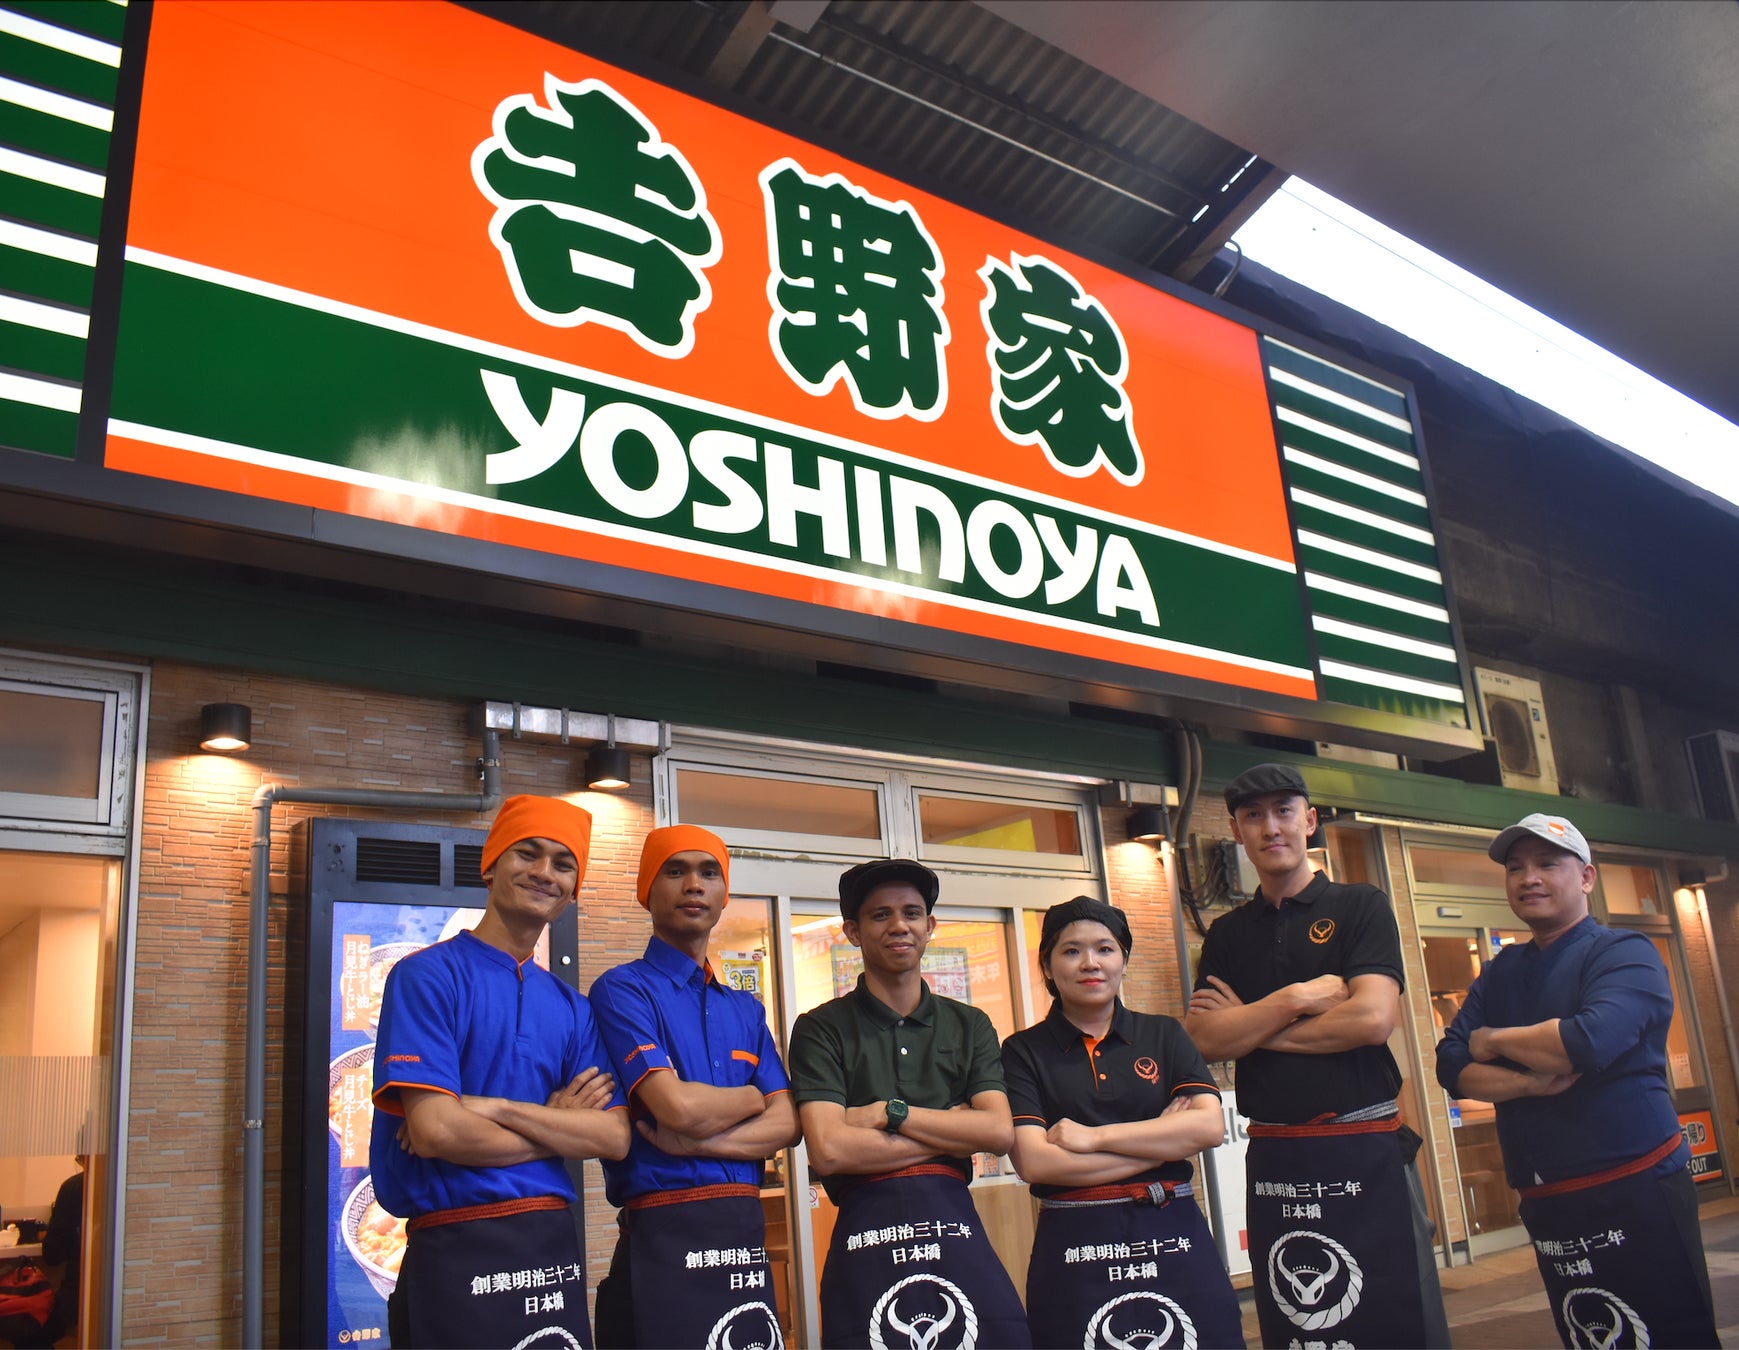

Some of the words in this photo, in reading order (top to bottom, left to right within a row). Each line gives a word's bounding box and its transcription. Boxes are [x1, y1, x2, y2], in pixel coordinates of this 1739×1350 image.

[479, 368, 1161, 628] YOSHINOYA
[729, 970, 756, 992] 3倍
[356, 1073, 369, 1111] チーズ
[1691, 1156, 1708, 1174] OUT
[1254, 1180, 1362, 1199] 創業明治三十二年
[1282, 1203, 1322, 1219] 日本橋
[846, 1220, 972, 1252] 創業明治三十二年
[892, 1243, 941, 1264] 日本橋
[1064, 1236, 1192, 1264] 創業明治三十二年
[1108, 1261, 1158, 1282] 日本橋
[525, 1290, 565, 1316] 日本橋
